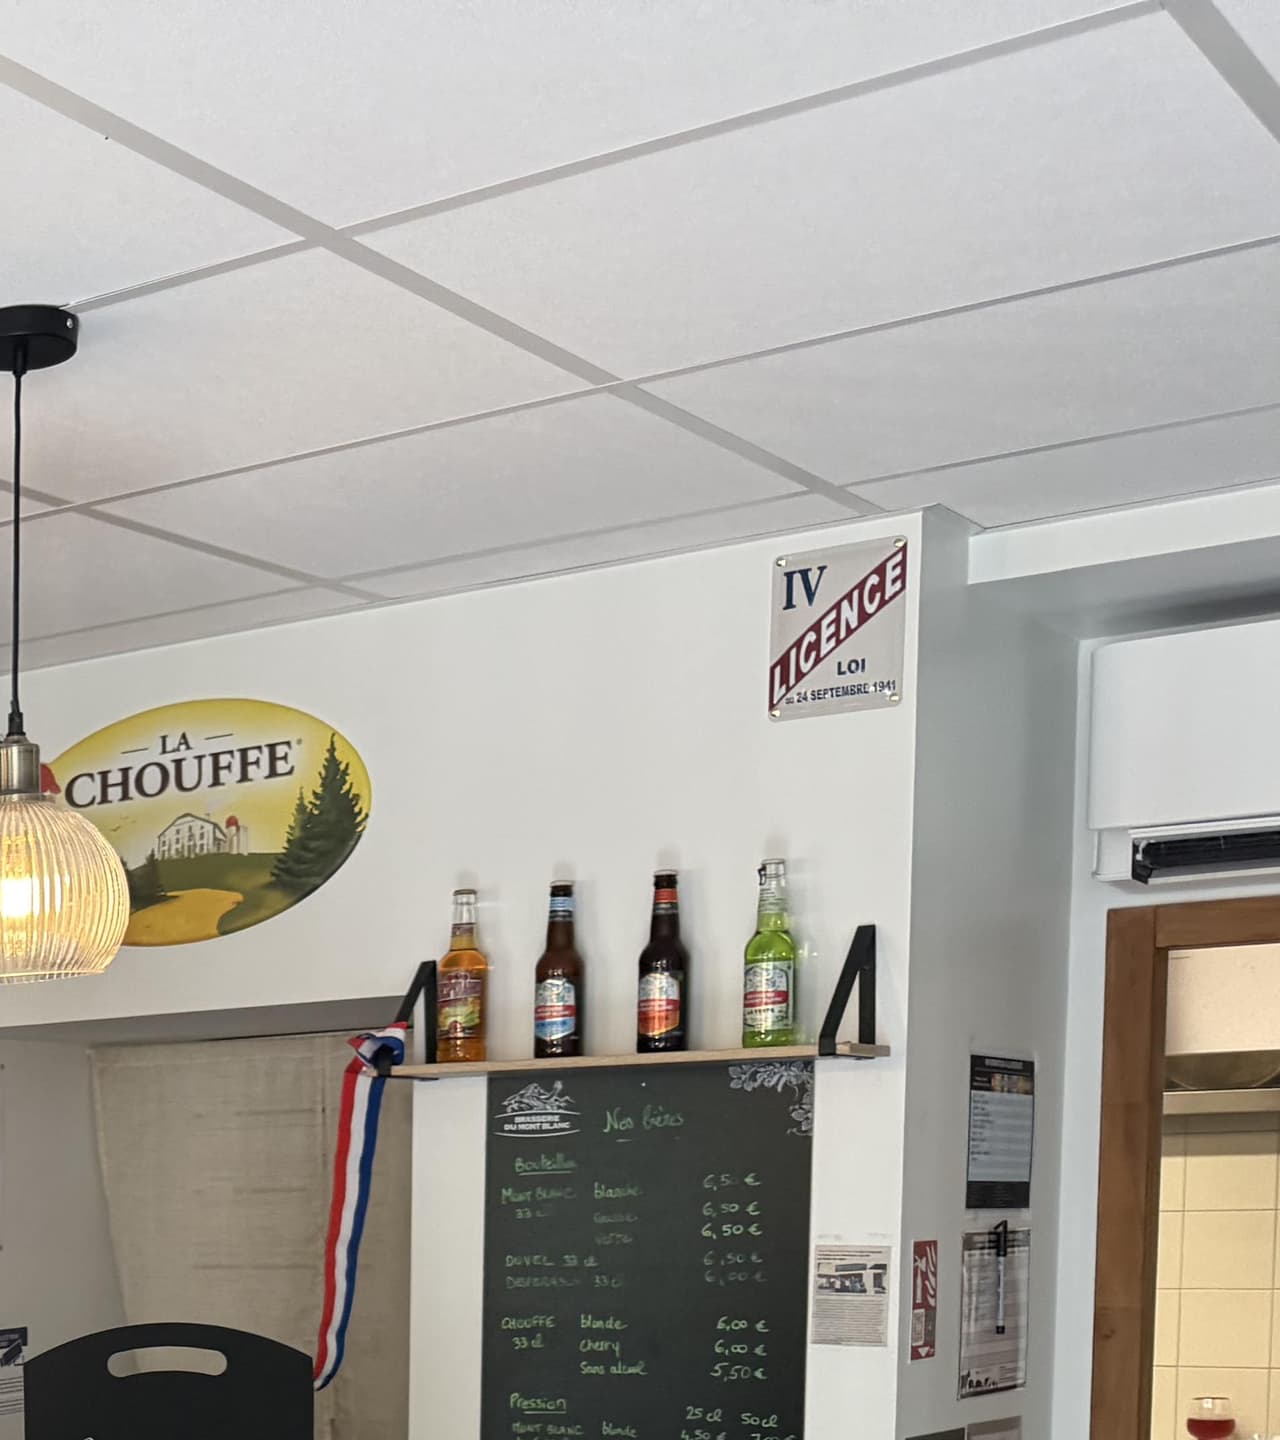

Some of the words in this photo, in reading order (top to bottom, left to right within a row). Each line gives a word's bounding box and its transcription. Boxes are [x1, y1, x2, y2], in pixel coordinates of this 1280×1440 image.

[783, 565, 827, 610] IV
[773, 551, 904, 704] LICENCE
[837, 658, 866, 675] LOI
[796, 692, 808, 703] 24
[810, 682, 870, 702] SEPTEMBRE
[873, 680, 896, 694] 1941
[159, 731, 193, 755] LA
[64, 740, 295, 809] CHOUFFE
[602, 1107, 635, 1133] Nos
[580, 1314, 629, 1331] blonde
[509, 1393, 567, 1411] Pression
[601, 1419, 638, 1438] blonde
